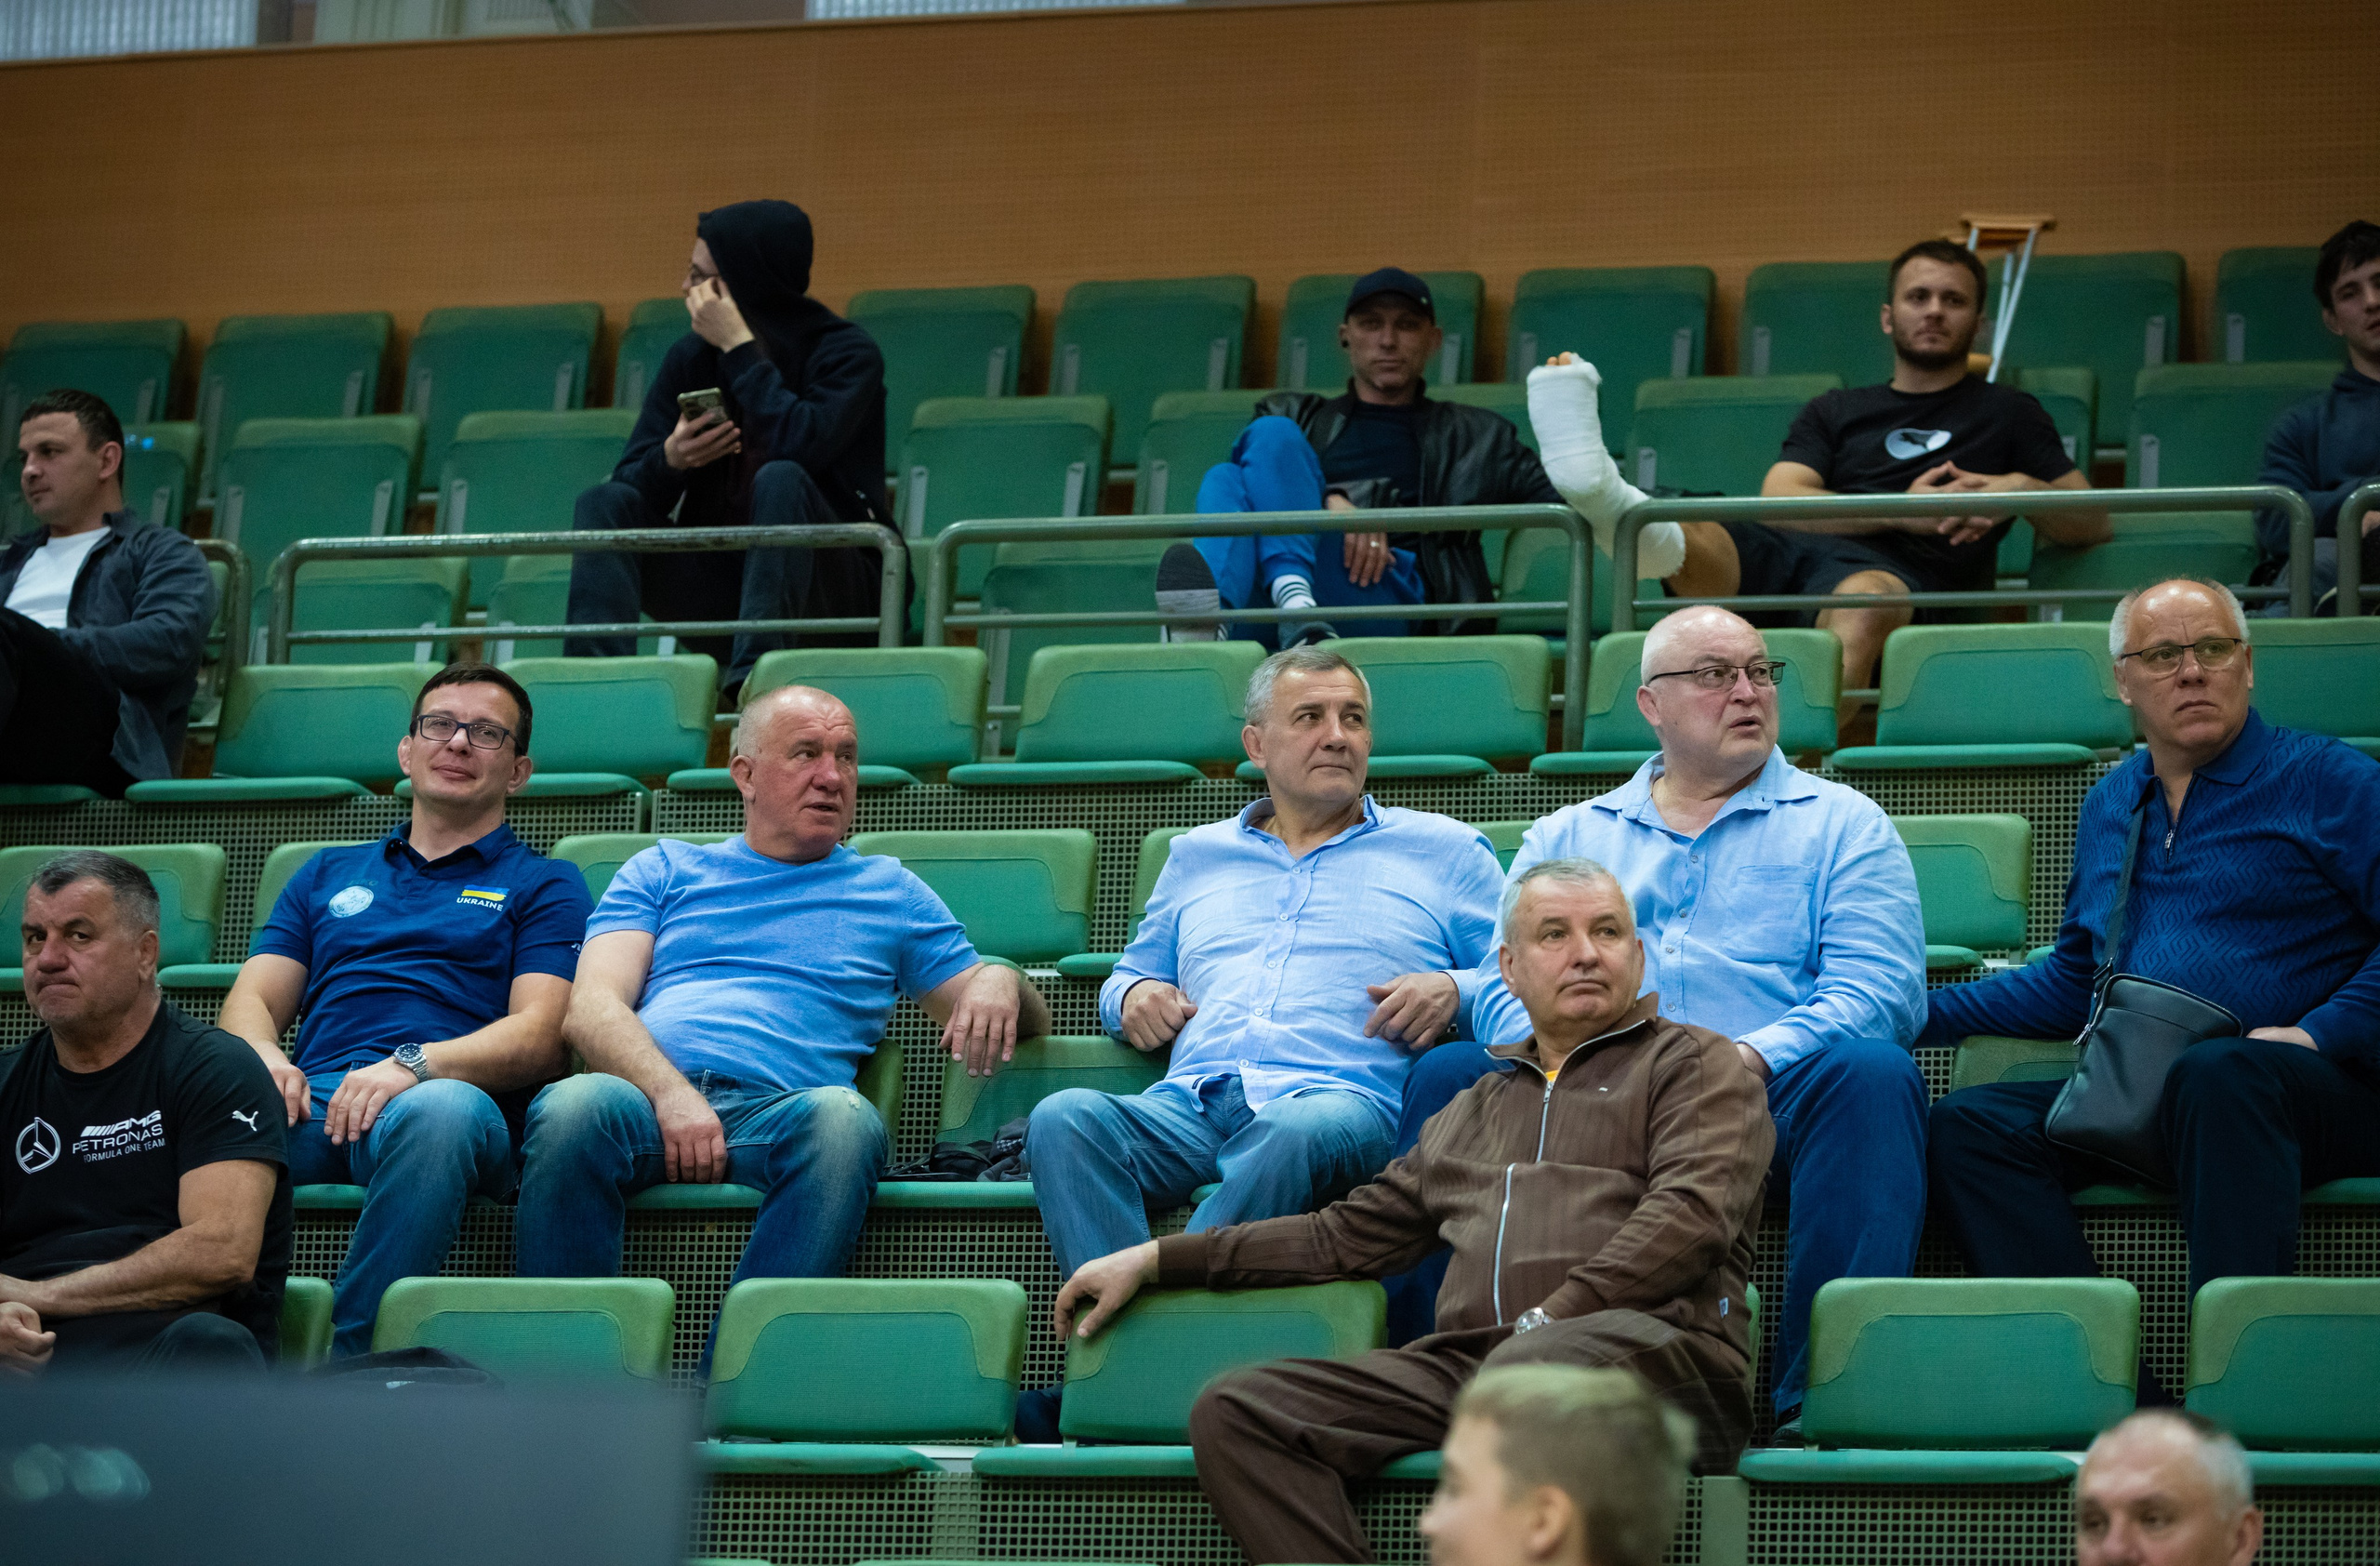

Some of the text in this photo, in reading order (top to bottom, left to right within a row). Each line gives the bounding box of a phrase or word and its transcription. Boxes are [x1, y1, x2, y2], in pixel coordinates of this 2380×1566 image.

[456, 896, 504, 911] UKRAINE
[73, 1123, 163, 1154] PETRONAS
[84, 1137, 166, 1163] FORMULA ONE TEAM
